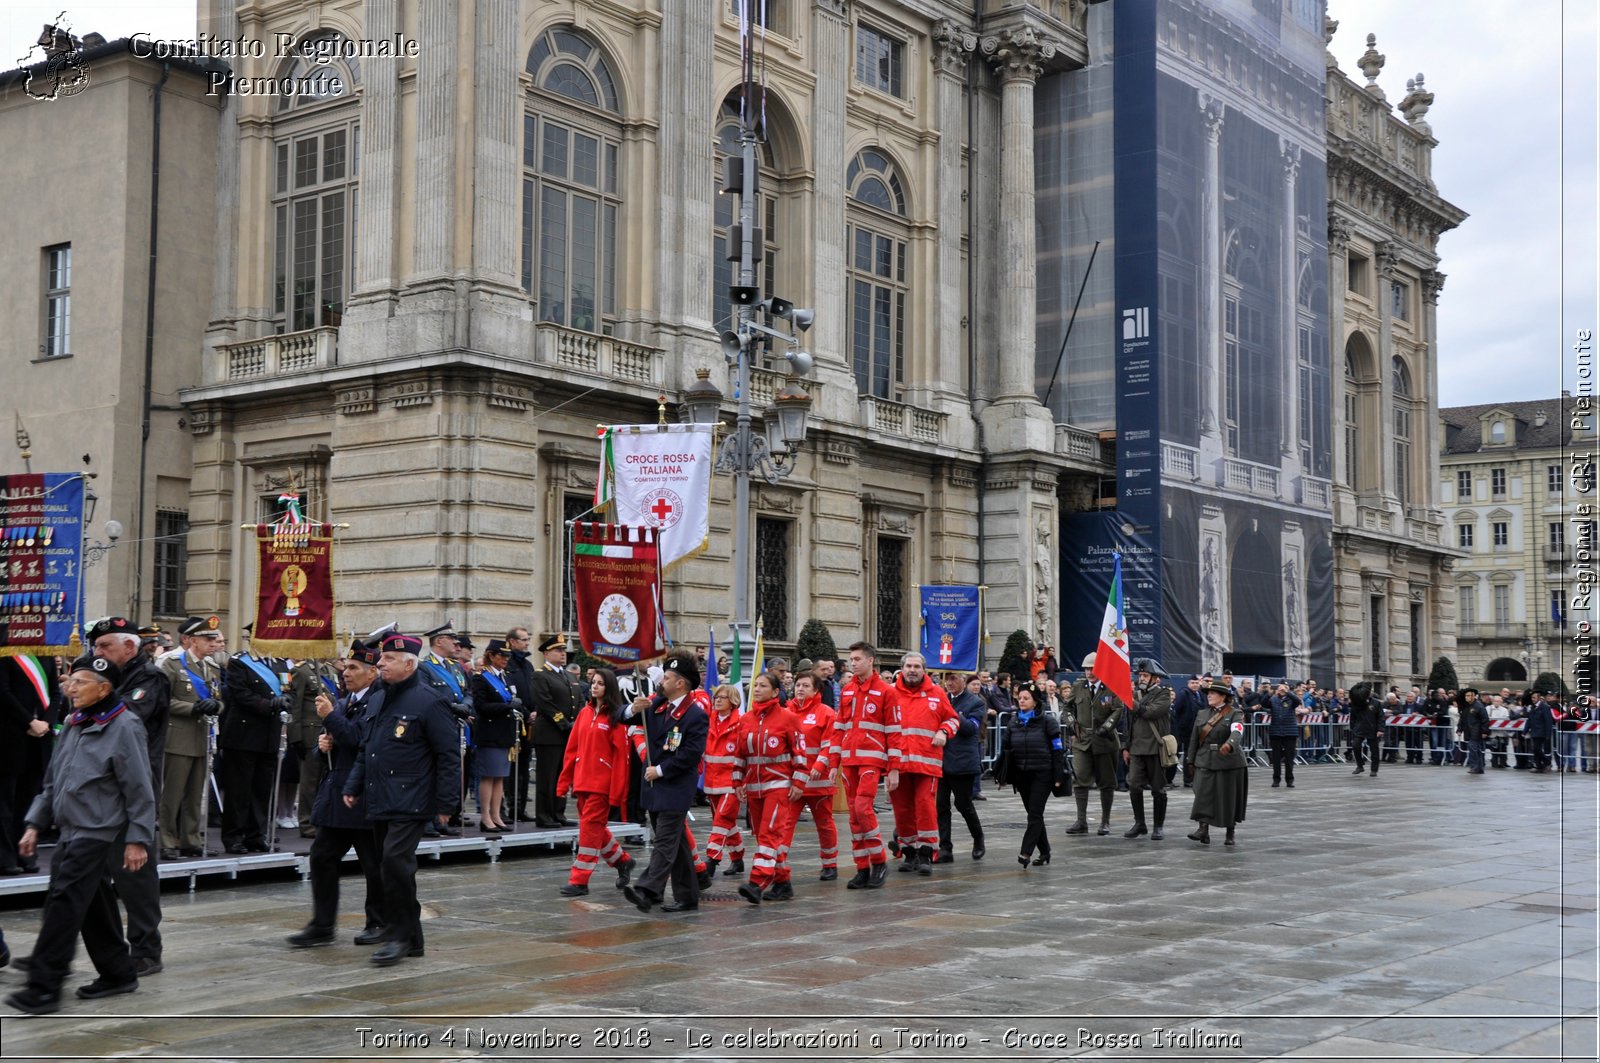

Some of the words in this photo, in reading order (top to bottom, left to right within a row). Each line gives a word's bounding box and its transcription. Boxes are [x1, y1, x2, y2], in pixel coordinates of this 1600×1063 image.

[625, 454, 659, 464] CROCE
[663, 453, 696, 463] ROSSA
[640, 465, 683, 475] ITALIANA
[1118, 545, 1153, 554] Madama
[590, 572, 608, 583] Croce
[11, 614, 42, 623] PIETRO
